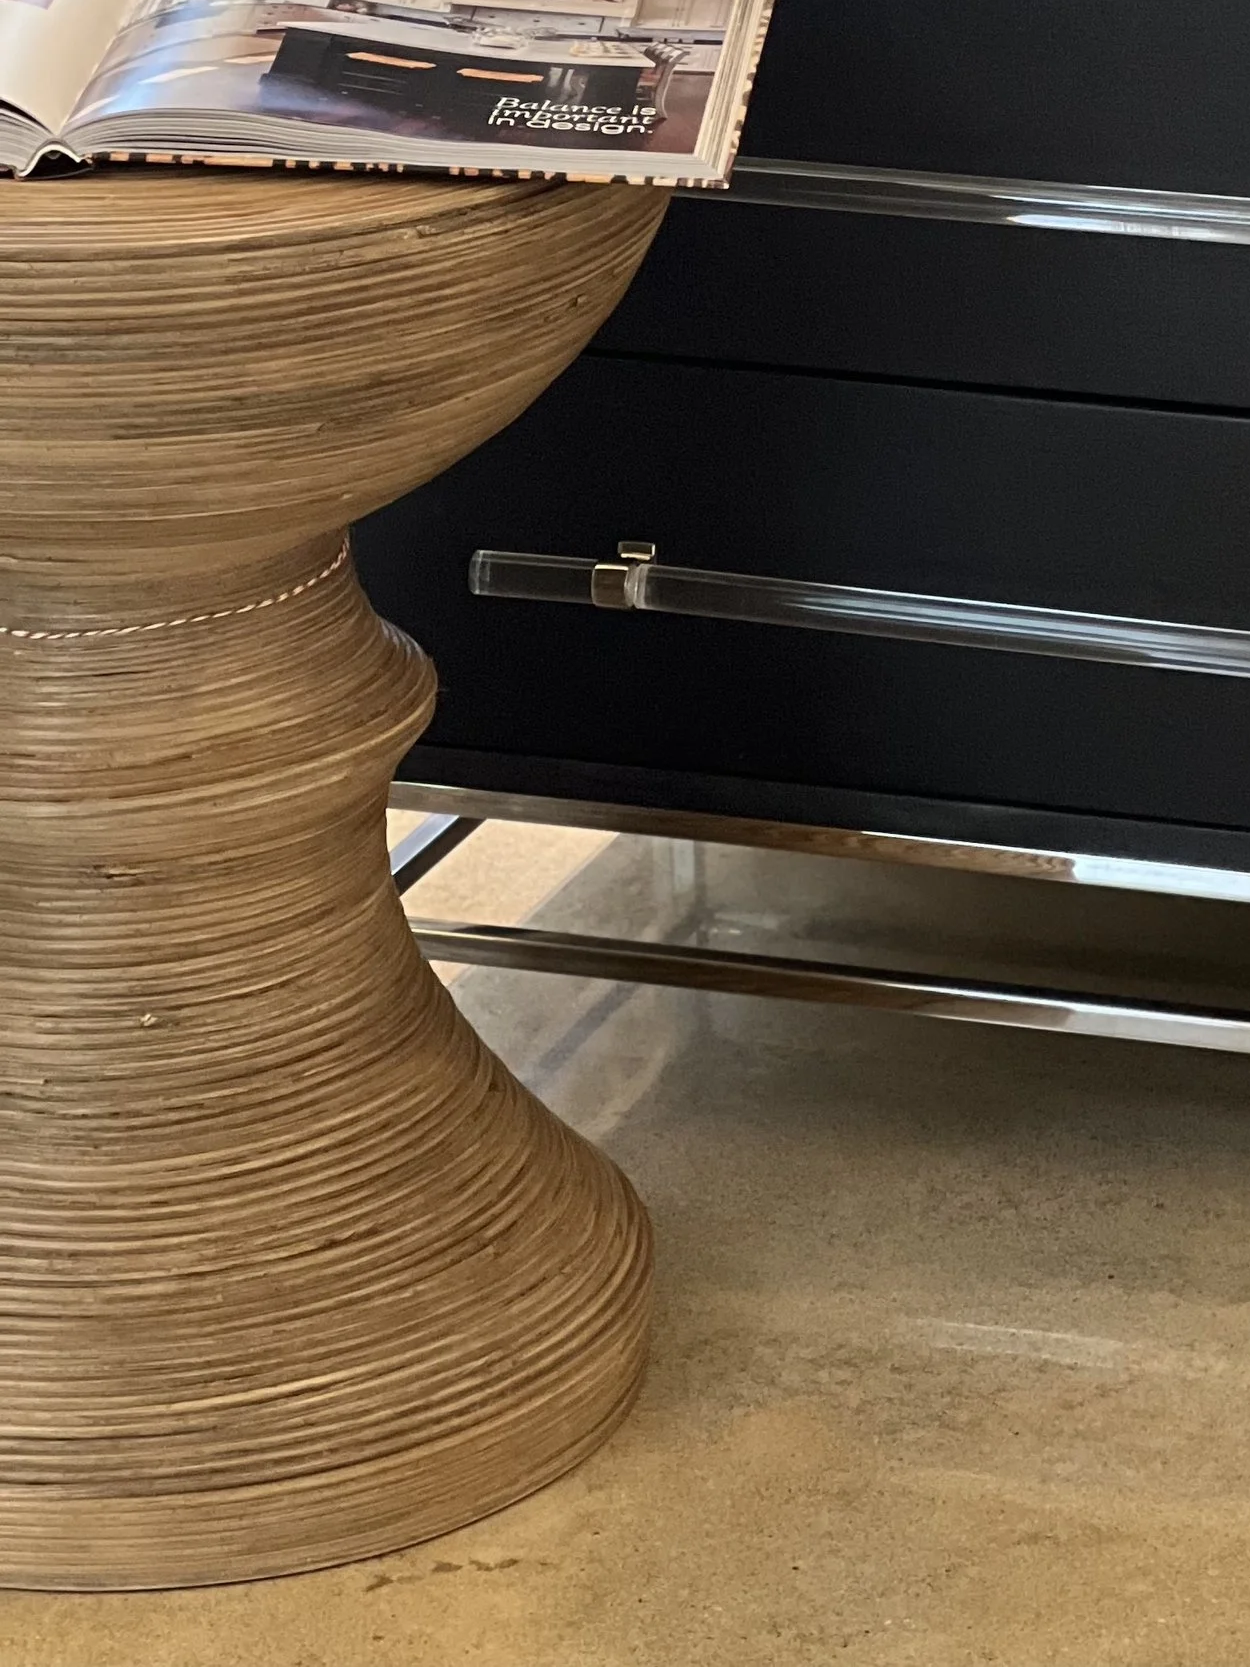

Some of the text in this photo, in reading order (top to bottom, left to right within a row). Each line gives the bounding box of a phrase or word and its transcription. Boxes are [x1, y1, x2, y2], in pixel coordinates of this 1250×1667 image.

[496, 97, 657, 116] Balance is
[488, 115, 654, 134] in design.
[492, 108, 656, 125] important
